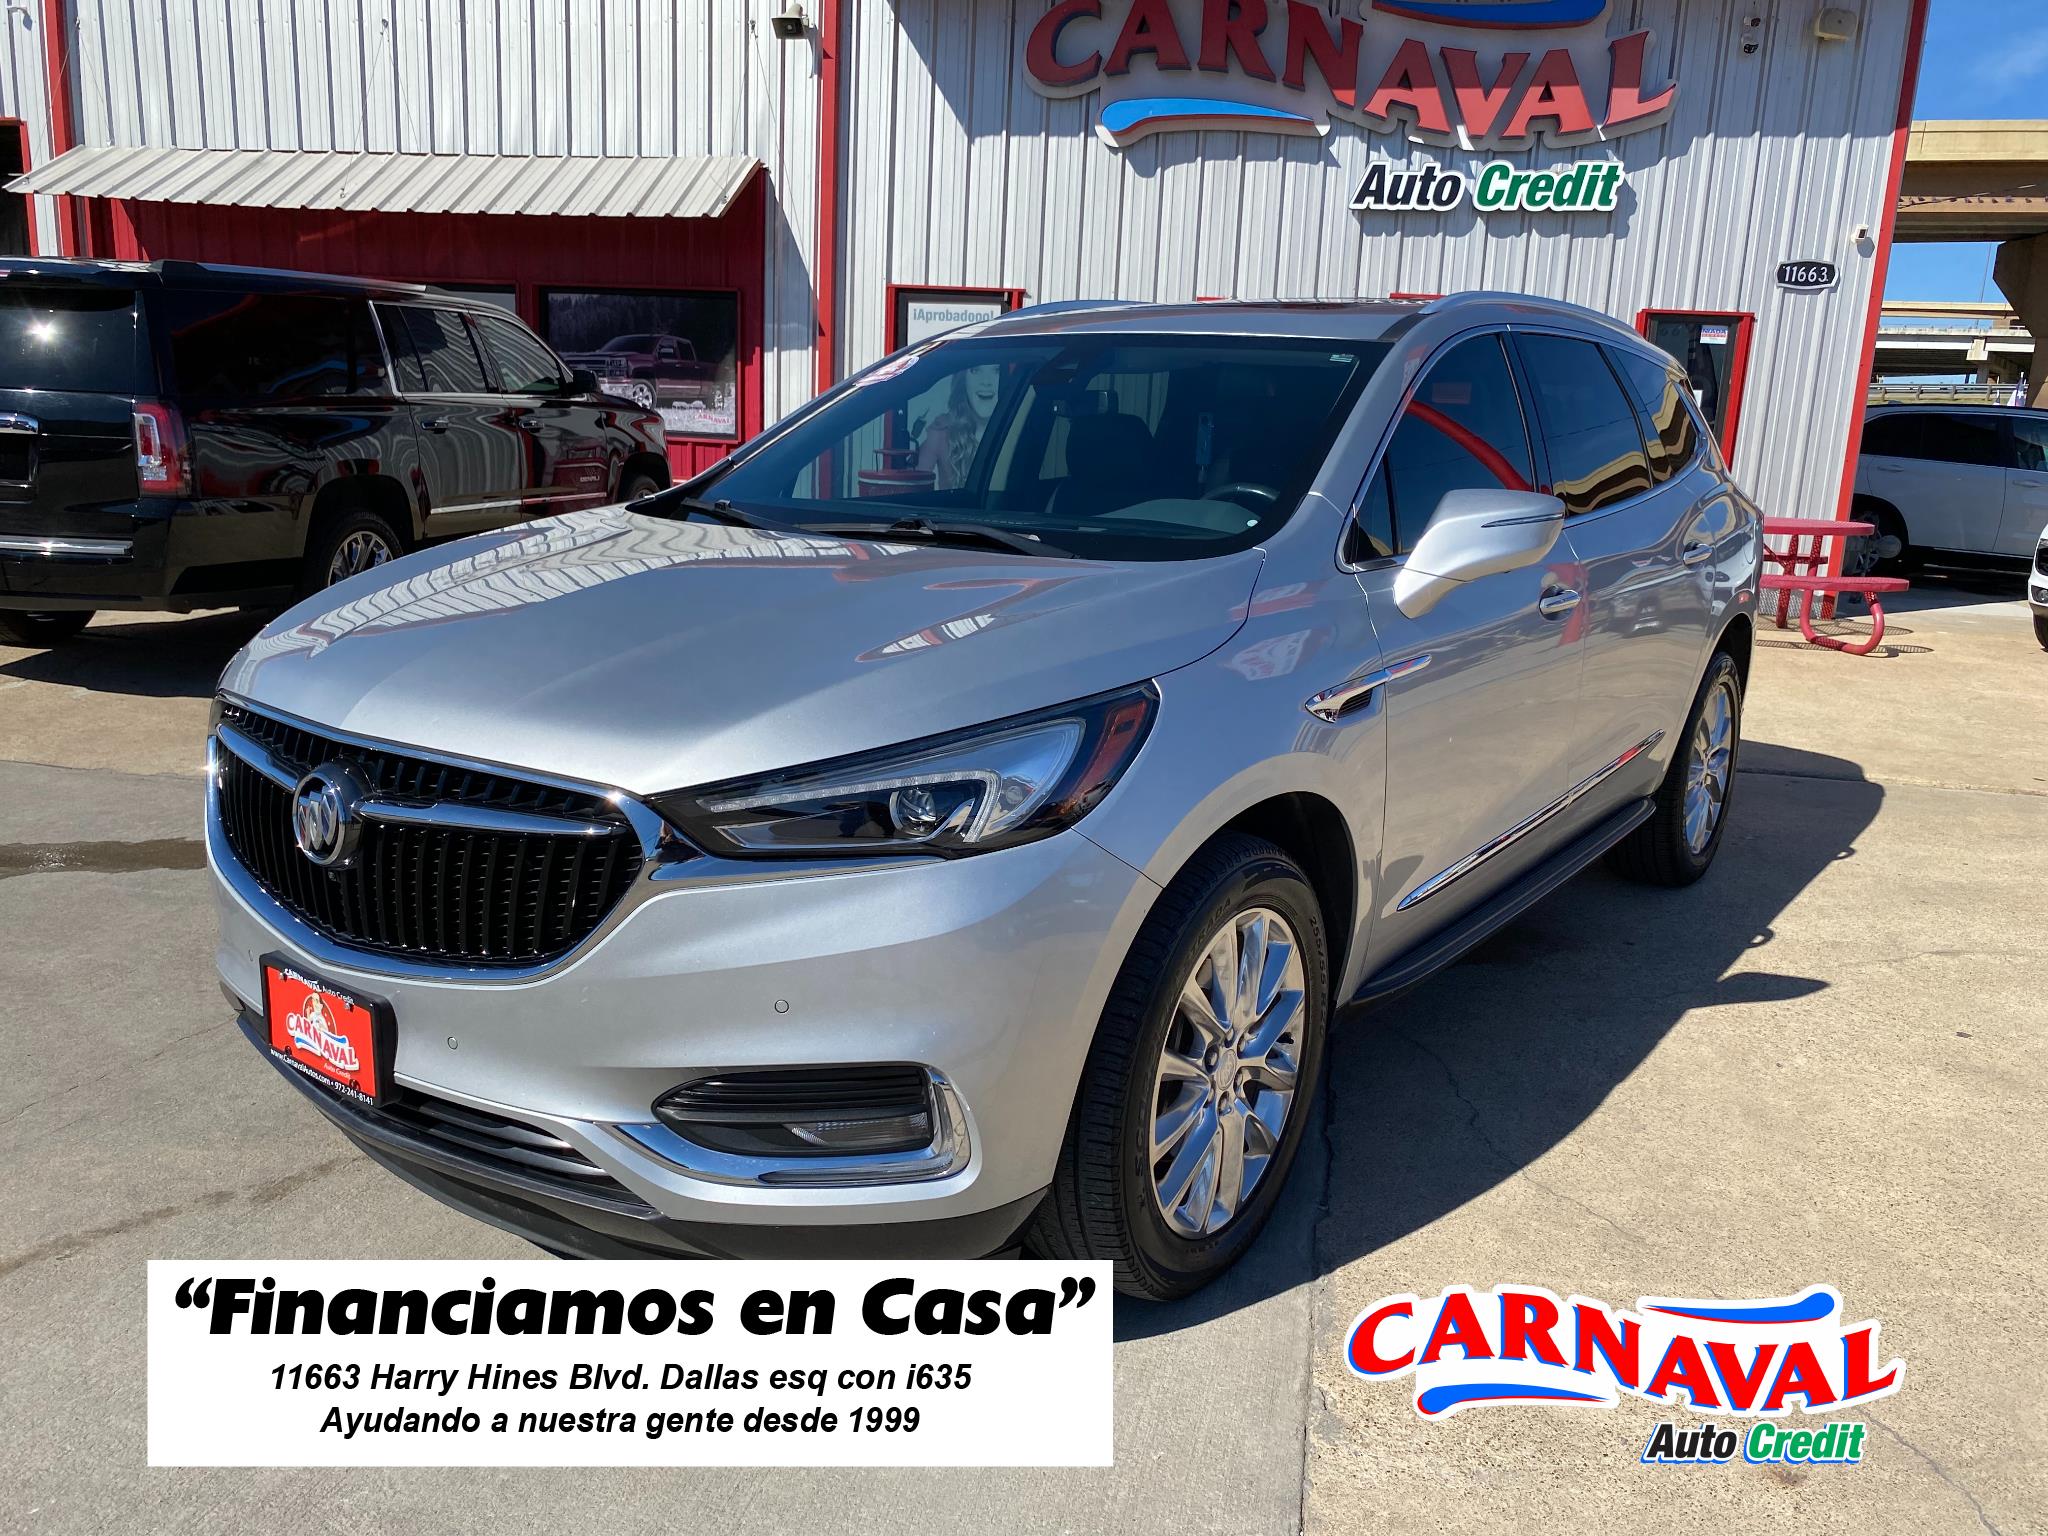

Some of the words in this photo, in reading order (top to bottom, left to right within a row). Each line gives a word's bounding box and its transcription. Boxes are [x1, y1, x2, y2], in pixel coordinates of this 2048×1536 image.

[1026, 0, 1676, 139] CARNAVAL
[1353, 164, 1461, 206] Auto
[1476, 163, 1621, 207] Credit
[1783, 265, 1829, 284] 11663
[286, 1012, 358, 1066] CARNAVAL
[323, 1062, 336, 1073] Auto
